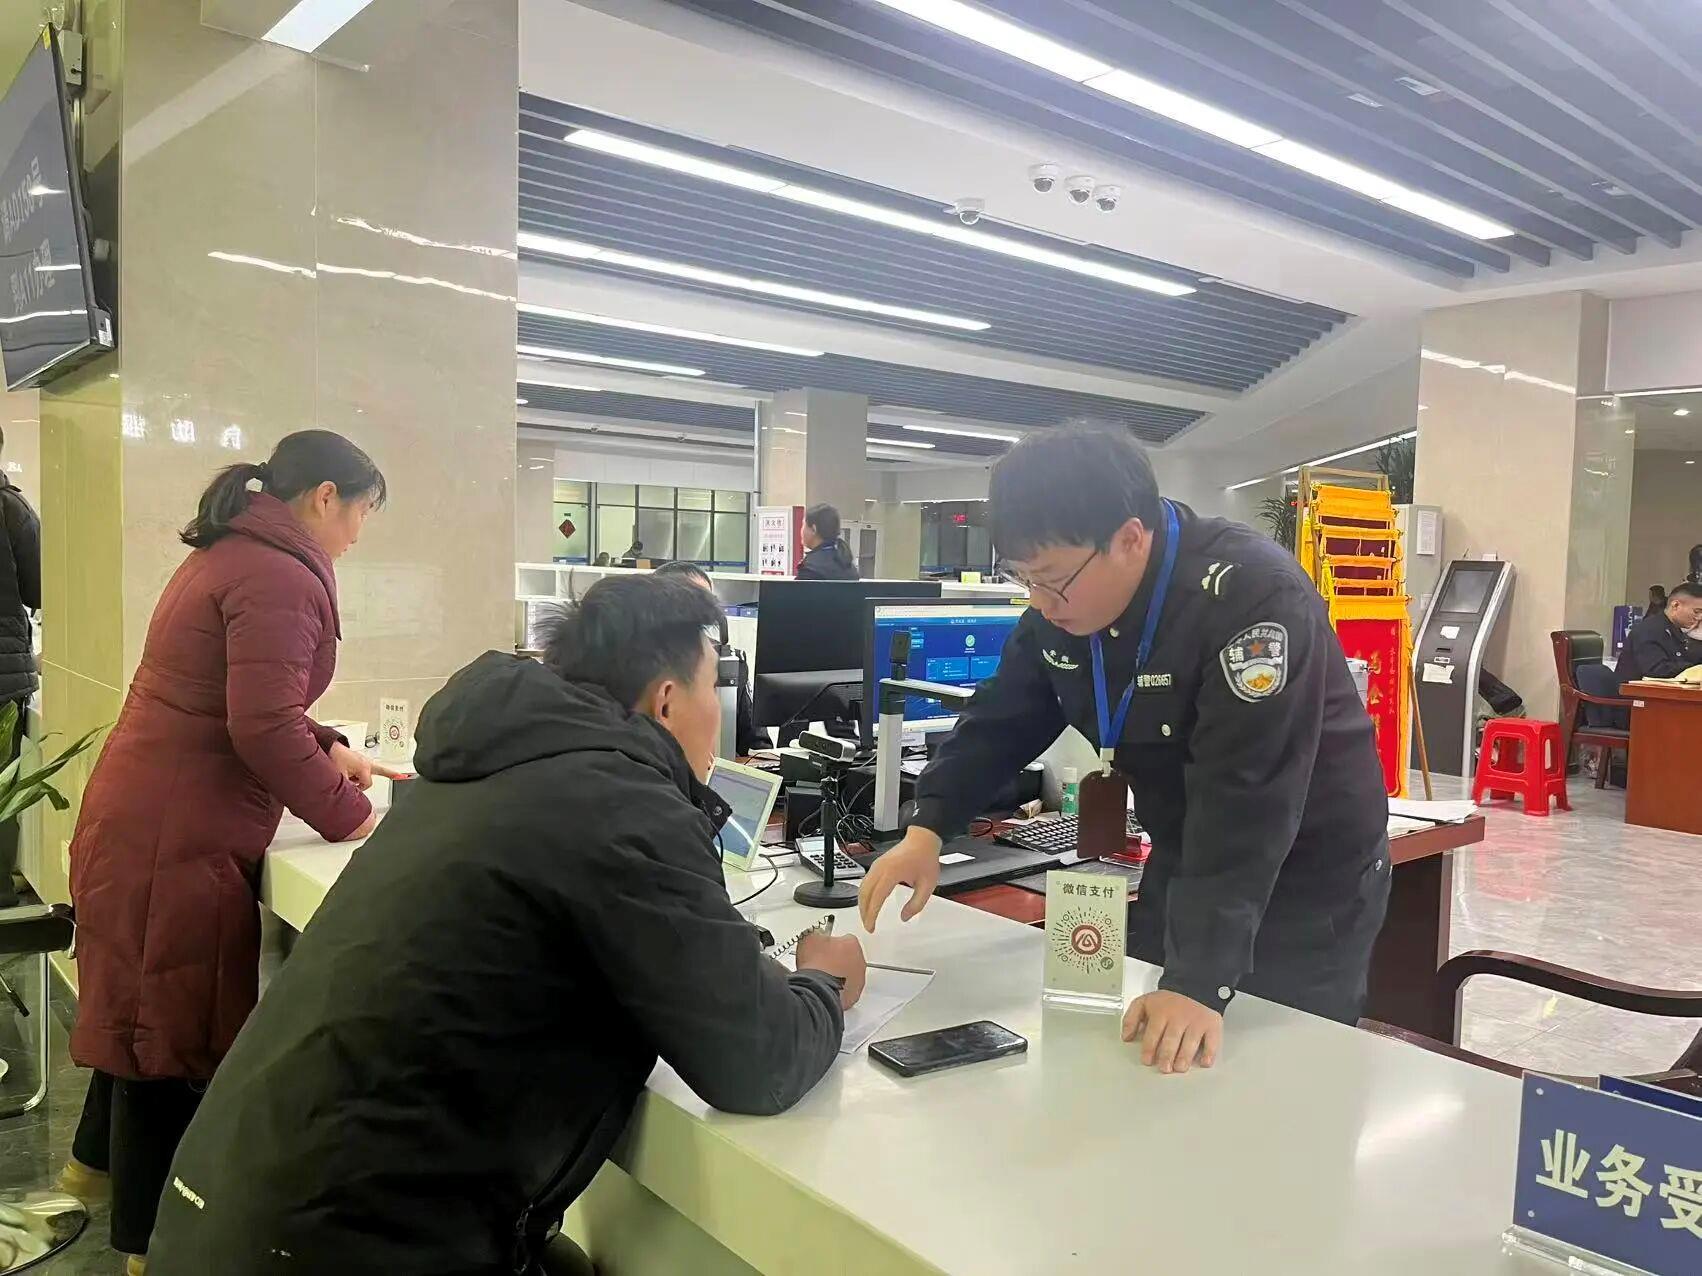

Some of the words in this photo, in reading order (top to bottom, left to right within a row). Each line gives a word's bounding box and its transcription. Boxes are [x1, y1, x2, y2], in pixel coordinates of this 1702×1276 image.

[1063, 883, 1114, 898] 微信支付
[1536, 1128, 1702, 1239] 业务受
